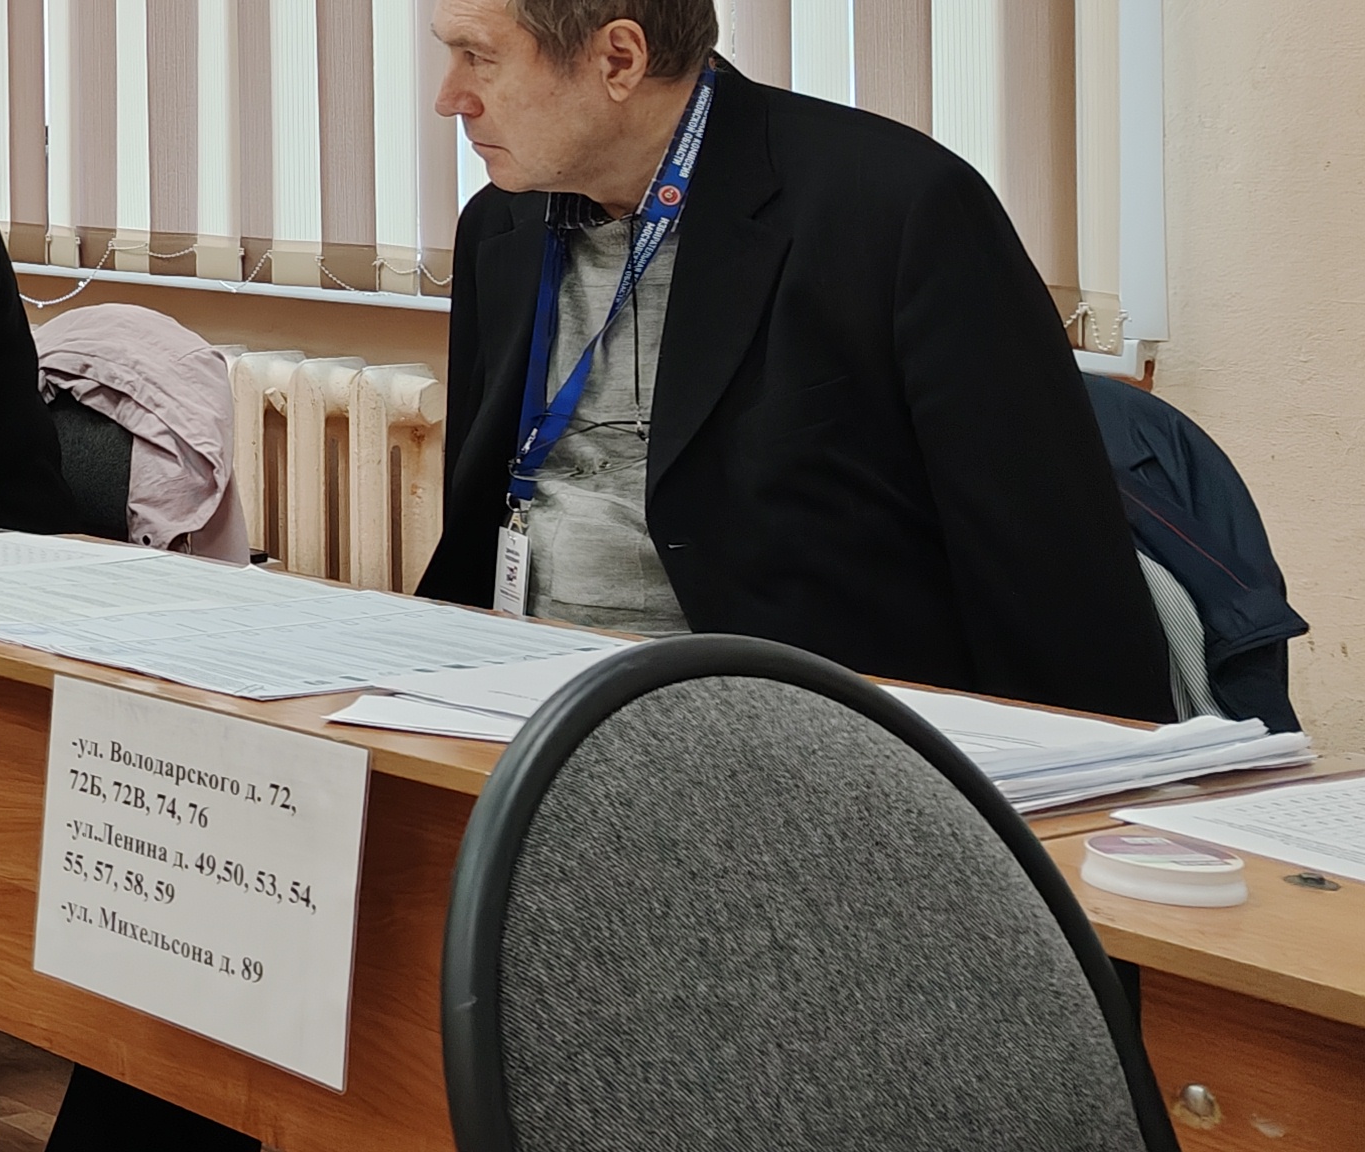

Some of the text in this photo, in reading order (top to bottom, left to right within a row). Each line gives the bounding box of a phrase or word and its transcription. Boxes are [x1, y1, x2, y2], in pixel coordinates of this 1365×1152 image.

[70, 768, 210, 829] 72Б, 72В, 74, 76
[72, 738, 297, 816] -ул. Володарского д. 72,
[62, 850, 175, 904] 55, 57, 58, 59
[66, 819, 317, 915] -ул.Ленина д. 49,50, 53, 54,
[61, 901, 263, 983] -ул. Михельсона д. 89
